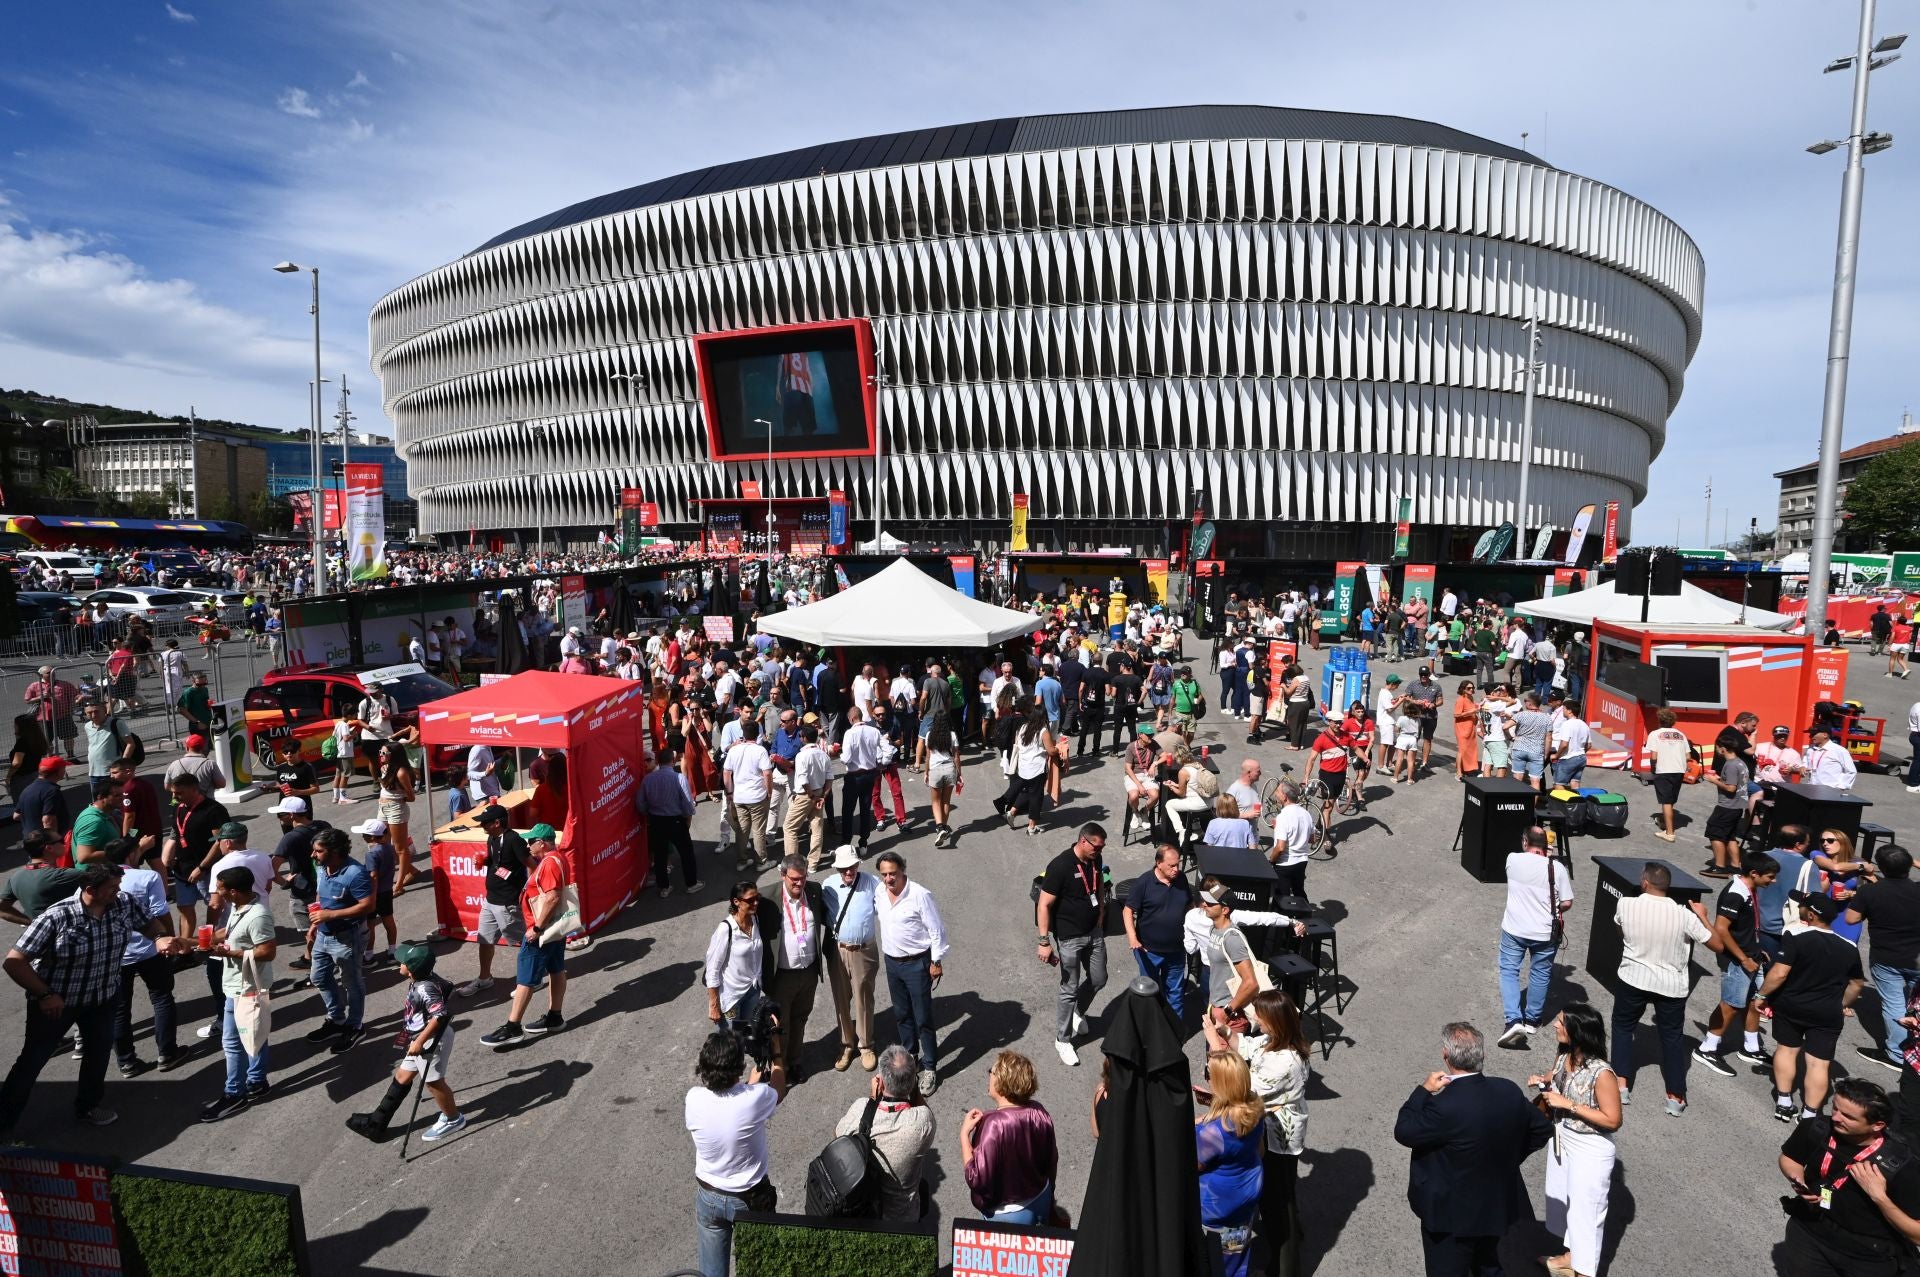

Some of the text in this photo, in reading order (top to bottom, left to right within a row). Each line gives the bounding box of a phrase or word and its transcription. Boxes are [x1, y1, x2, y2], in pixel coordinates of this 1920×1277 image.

[1609, 541, 1613, 549] LA
[1339, 583, 1350, 616] caser
[1602, 700, 1627, 723] LA VUELTA
[470, 726, 503, 735] avianca
[279, 772, 298, 782] FILA
[602, 761, 618, 778] Date
[598, 773, 620, 793] vuelta
[1497, 803, 1525, 811] LA VUELTA
[32, 1195, 95, 1222] SEGUNDO
[953, 1245, 993, 1272] EBRA
[997, 1250, 1039, 1277] CADA
